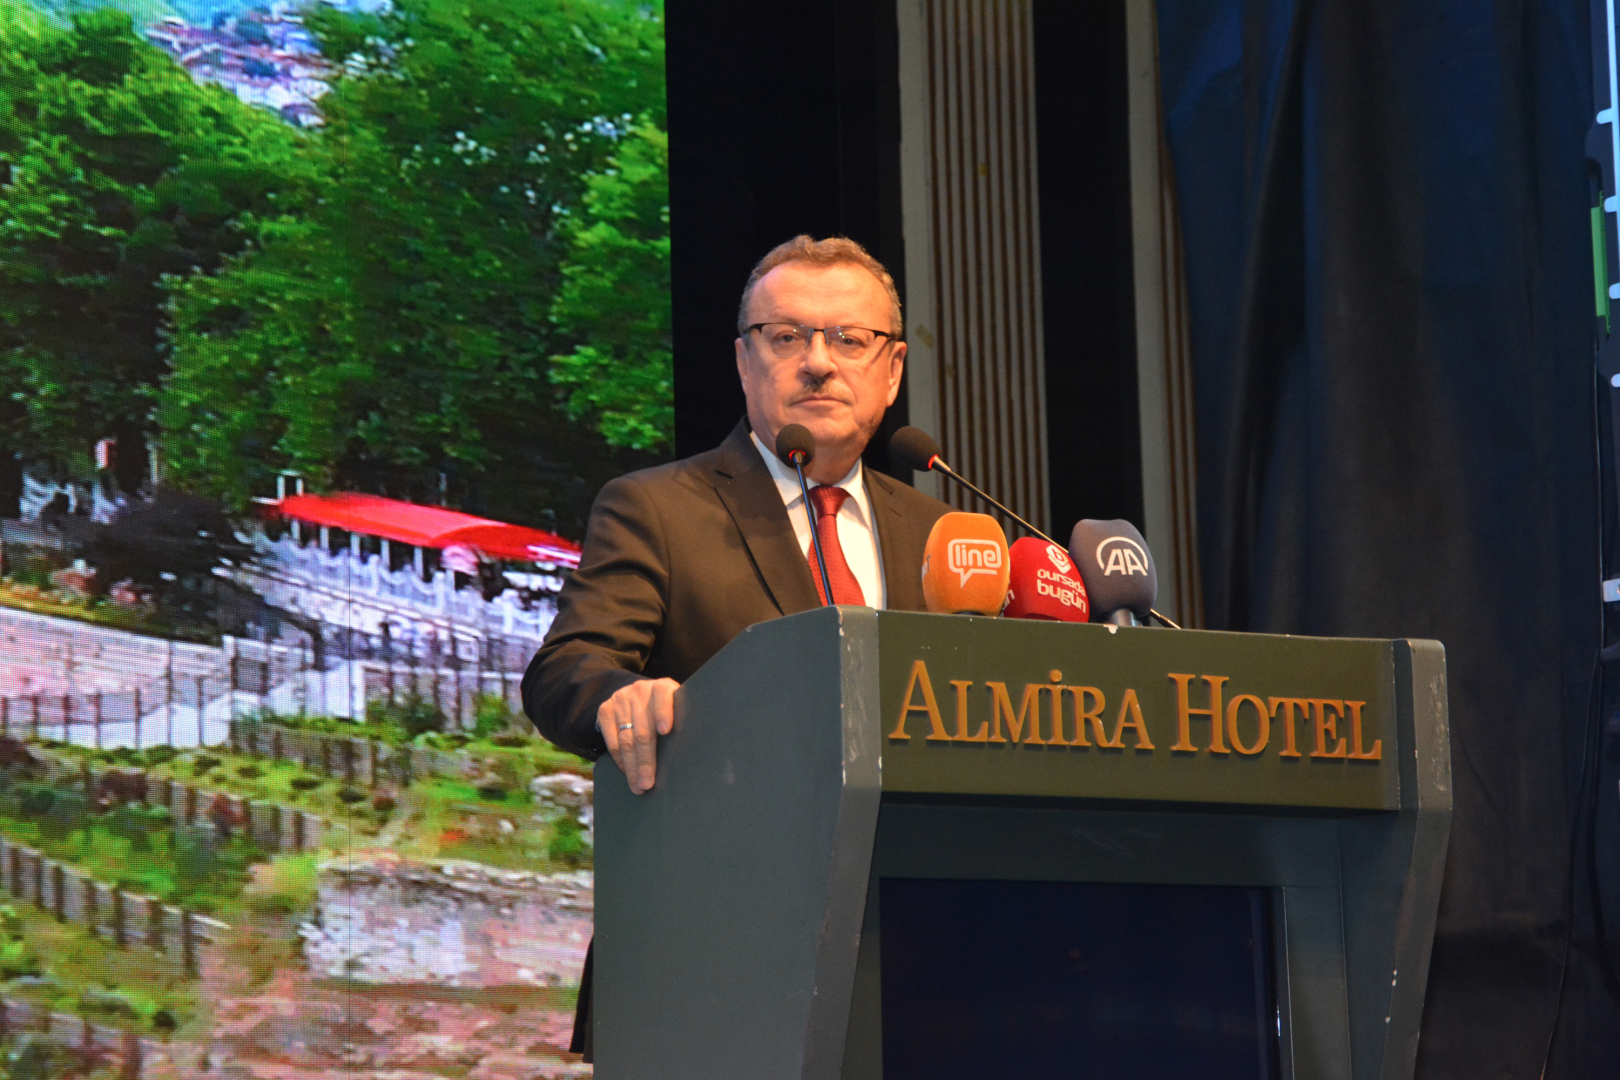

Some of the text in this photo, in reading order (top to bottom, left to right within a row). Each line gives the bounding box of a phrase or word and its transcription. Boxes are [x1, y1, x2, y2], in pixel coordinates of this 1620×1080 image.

[954, 545, 998, 569] line
[1104, 548, 1148, 576] AA
[1036, 579, 1087, 614] bugün
[1166, 672, 1383, 760] HOTEL
